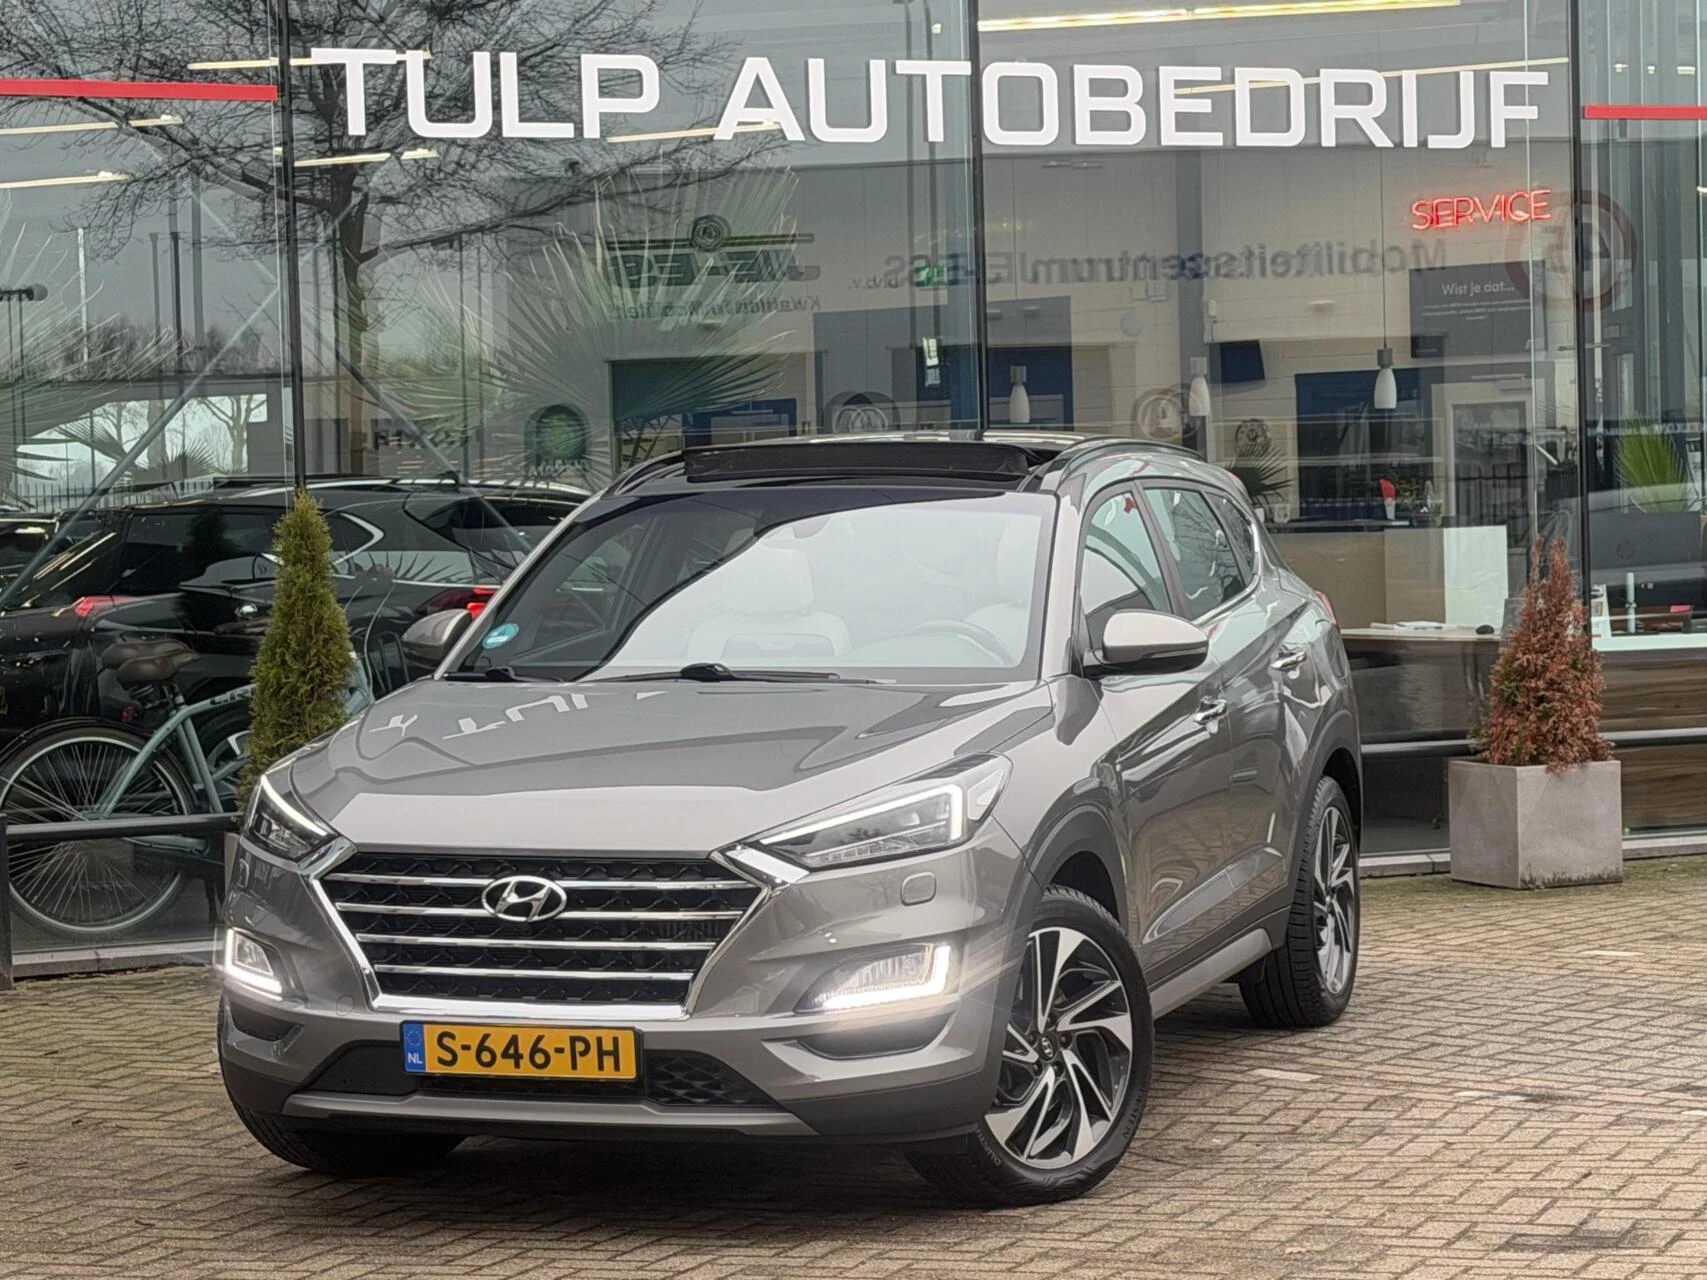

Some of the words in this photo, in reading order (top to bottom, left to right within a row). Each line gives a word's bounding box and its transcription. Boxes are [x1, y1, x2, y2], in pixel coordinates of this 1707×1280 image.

[311, 48, 660, 138] TULP
[714, 58, 1549, 149] AUTOBEDRIJF
[1412, 189, 1551, 230] SERVICE
[1442, 283, 1467, 296] Wist
[1469, 281, 1481, 296] je
[408, 1052, 424, 1064] NL
[437, 1031, 620, 1072] S-646-PH
